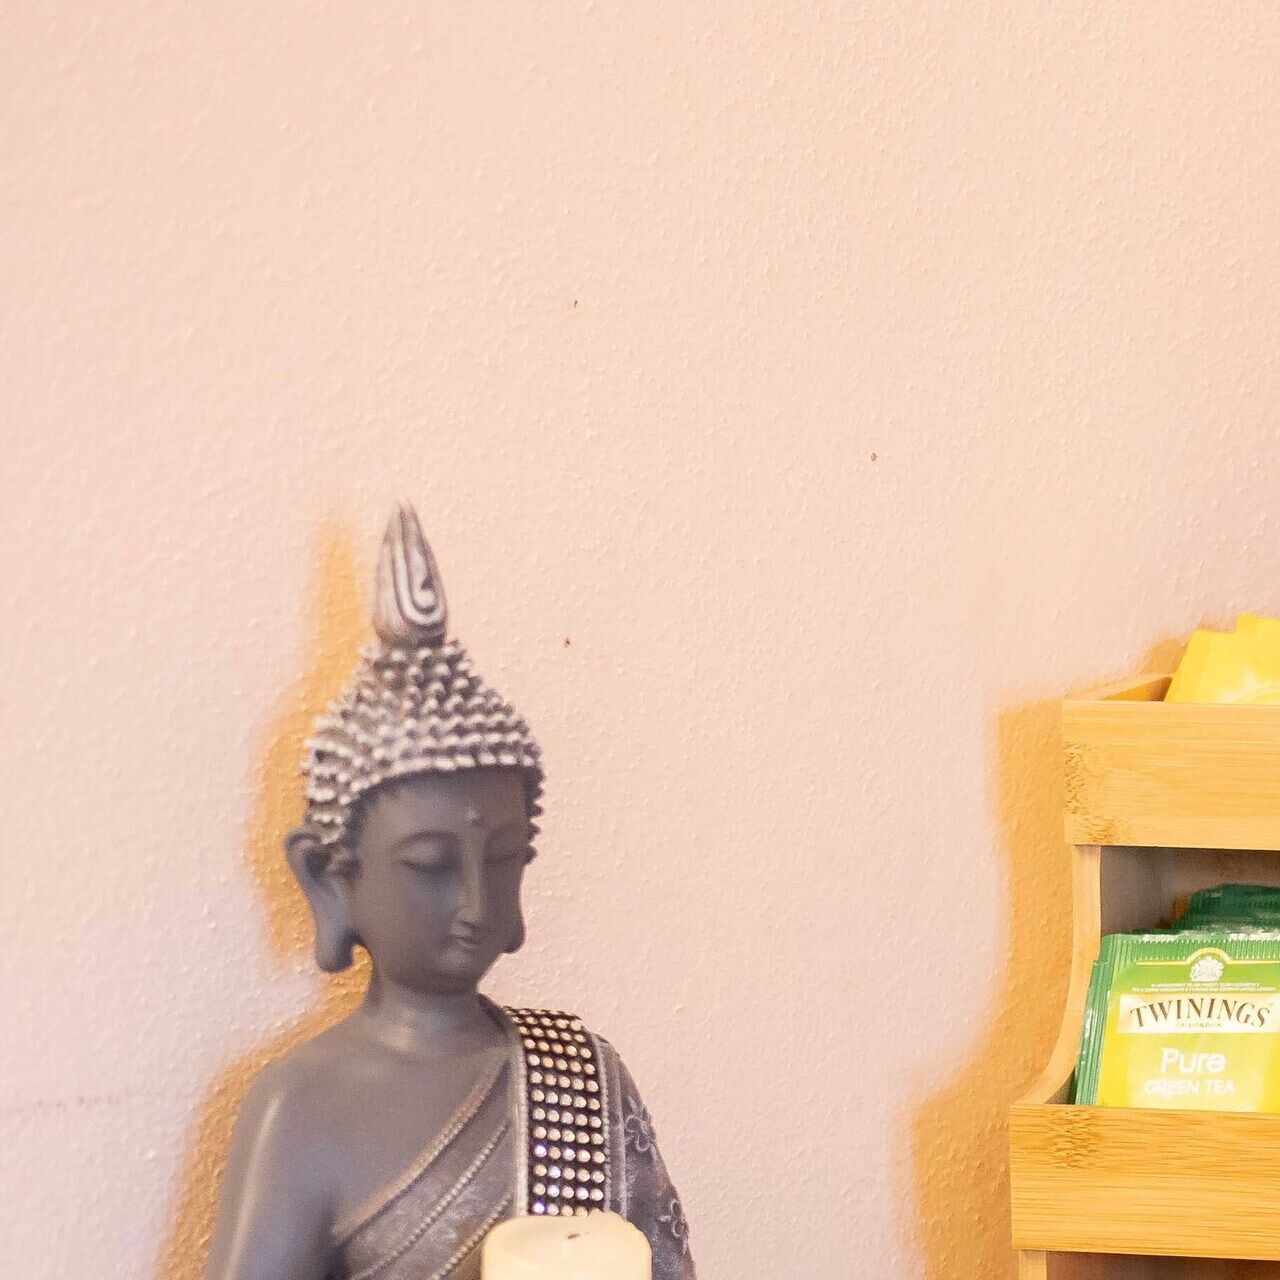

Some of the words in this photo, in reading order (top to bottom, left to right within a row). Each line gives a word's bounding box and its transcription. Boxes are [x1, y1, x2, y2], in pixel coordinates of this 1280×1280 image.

[1130, 998, 1270, 1027] TWININGS
[1160, 1048, 1227, 1073] Pure
[1204, 1078, 1236, 1095] TEA
